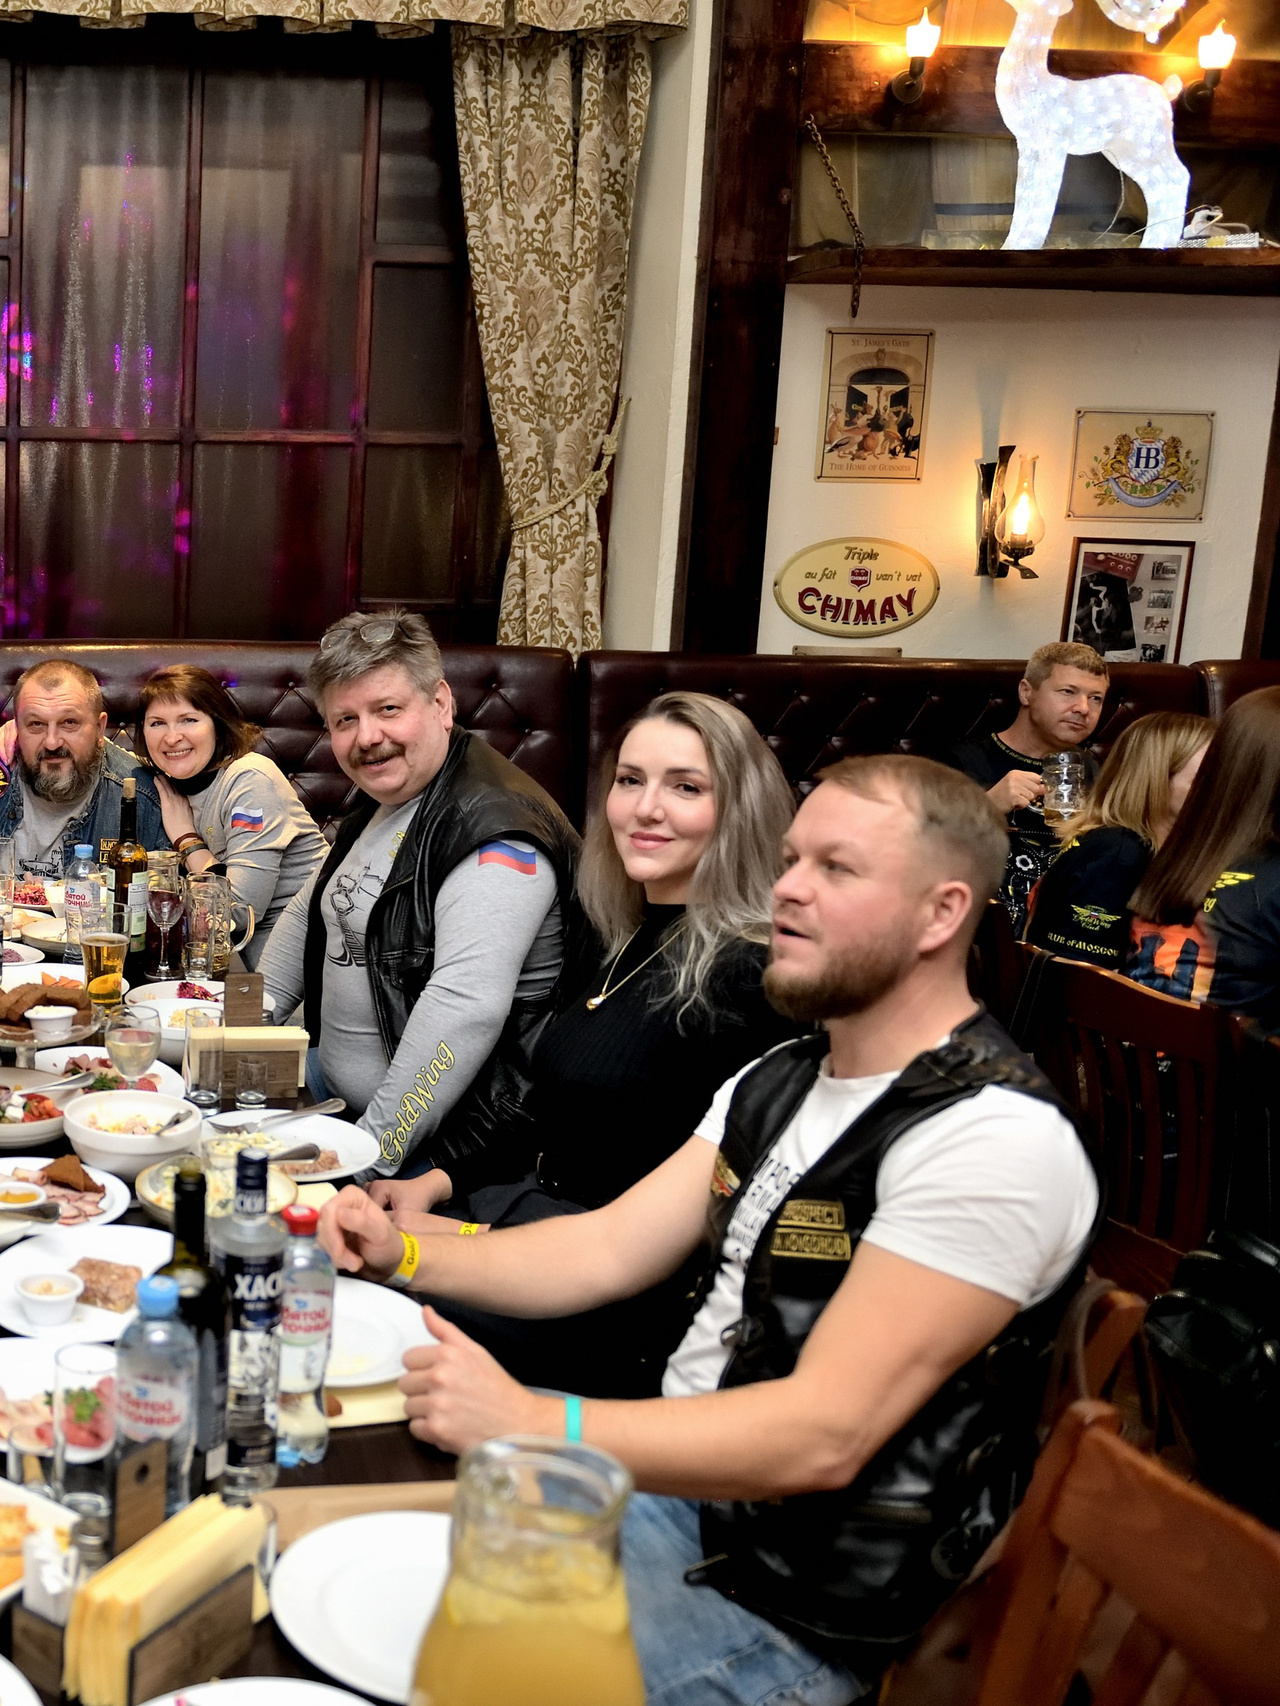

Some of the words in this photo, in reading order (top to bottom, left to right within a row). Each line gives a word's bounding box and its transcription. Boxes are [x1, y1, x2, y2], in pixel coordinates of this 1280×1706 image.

[892, 339, 910, 347] GATE
[829, 462, 844, 470] THE
[846, 463, 866, 471] HOME
[878, 464, 912, 472] GUINNESS
[1134, 447, 1160, 469] HB
[844, 546, 880, 564] Triple
[804, 571, 817, 580] au
[818, 568, 836, 582] fût
[906, 572, 922, 582] vat
[798, 587, 917, 625] CHIMAY
[379, 1040, 456, 1166] GoldWing
